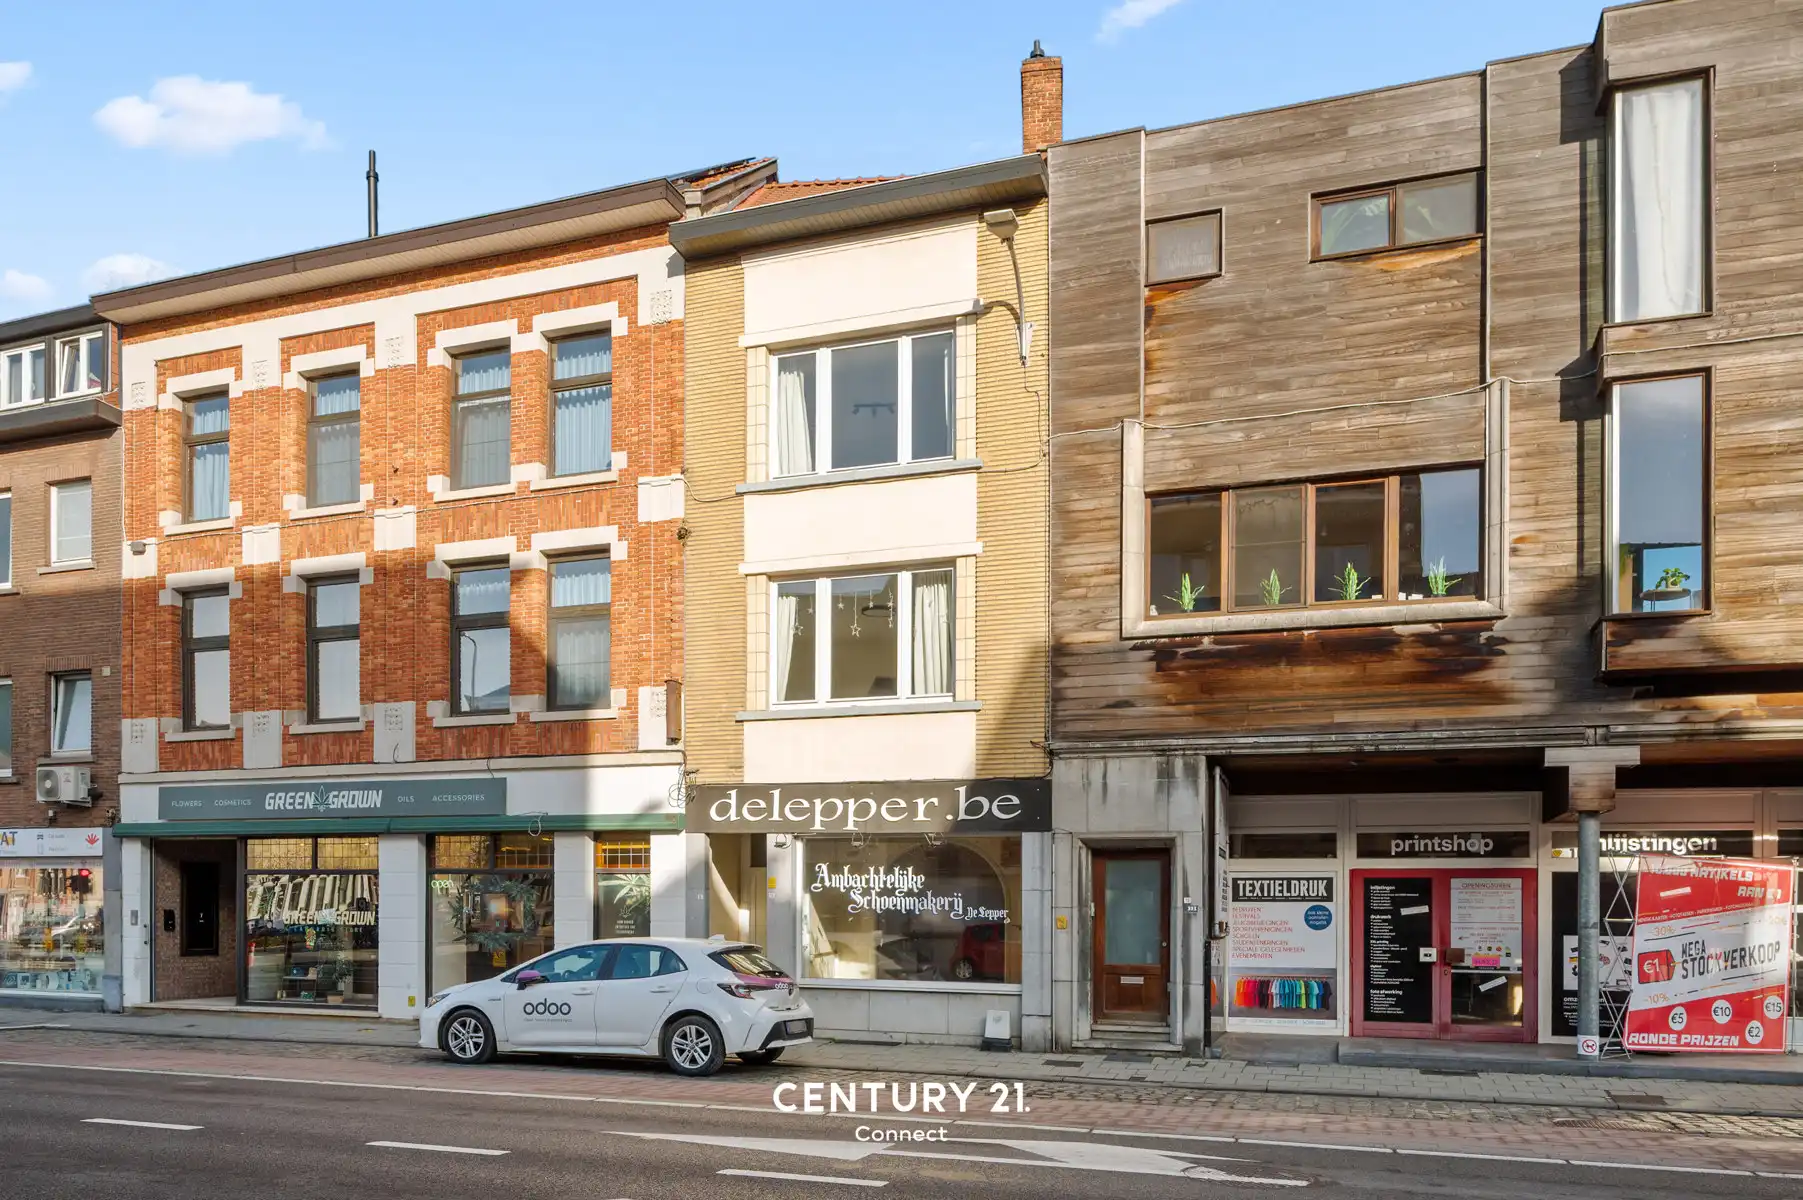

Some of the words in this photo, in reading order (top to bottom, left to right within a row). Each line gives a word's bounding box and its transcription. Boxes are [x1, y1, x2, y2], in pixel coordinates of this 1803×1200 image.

[214, 799, 252, 807] COSMETICS
[264, 791, 313, 810] GREEN
[329, 789, 382, 809] GROWN
[397, 795, 415, 803] OILS
[432, 794, 485, 802] ACCESSORIES
[709, 786, 1022, 832] delepper.be
[1390, 834, 1494, 856] printshop
[1237, 879, 1328, 897] TEXTIELDRUK
[1681, 939, 1706, 959] MEGA
[1643, 958, 1661, 974] €1
[522, 998, 572, 1016] odoo
[1713, 1005, 1731, 1017] €10
[1765, 1001, 1782, 1013] €15
[1671, 1012, 1684, 1024] €5
[1628, 1033, 1679, 1045] RONDE
[1682, 1034, 1740, 1047] PRIJZEN
[1748, 1026, 1761, 1038] €2
